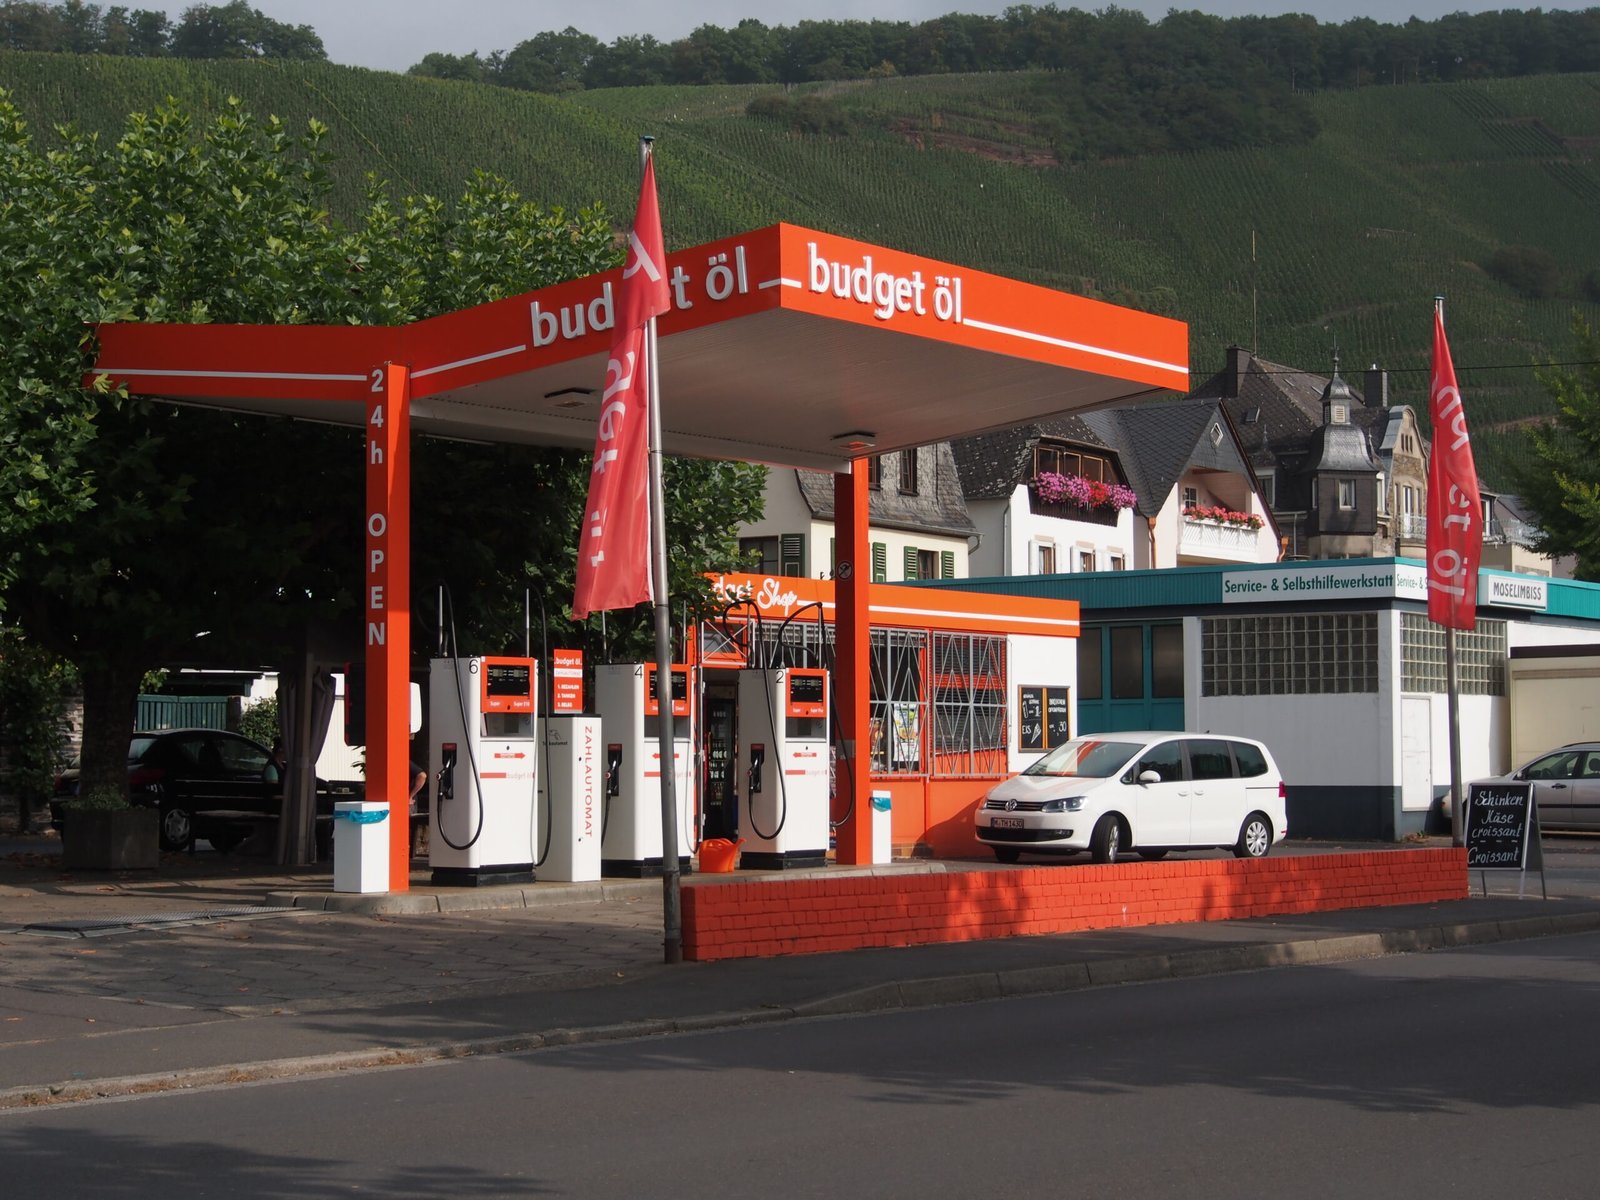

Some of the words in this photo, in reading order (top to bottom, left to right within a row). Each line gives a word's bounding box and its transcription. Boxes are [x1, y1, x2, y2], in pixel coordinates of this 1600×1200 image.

[807, 242, 927, 320] budget
[933, 275, 963, 323] öl
[530, 264, 693, 348] budt
[705, 245, 749, 301] öl
[369, 368, 385, 465] 24h
[368, 513, 387, 646] OPEN
[1396, 573, 1418, 590] Service-
[1419, 578, 1424, 590] &
[1428, 549, 1469, 597] öl
[1224, 579, 1267, 594] Service-
[1271, 577, 1280, 592] &
[1282, 573, 1394, 591] Selbsthilfewerkstatt
[1493, 581, 1542, 601] MOSELIMBISS
[757, 578, 798, 617] Shop
[469, 658, 479, 675] 6
[634, 665, 643, 679] 4
[776, 670, 785, 684] 2
[584, 725, 593, 838] ZAHLAUTOMAT
[1474, 790, 1524, 807] Schinken
[1481, 809, 1515, 825] Käse
[1471, 822, 1524, 839] croissant
[1467, 846, 1520, 865] Croissant
